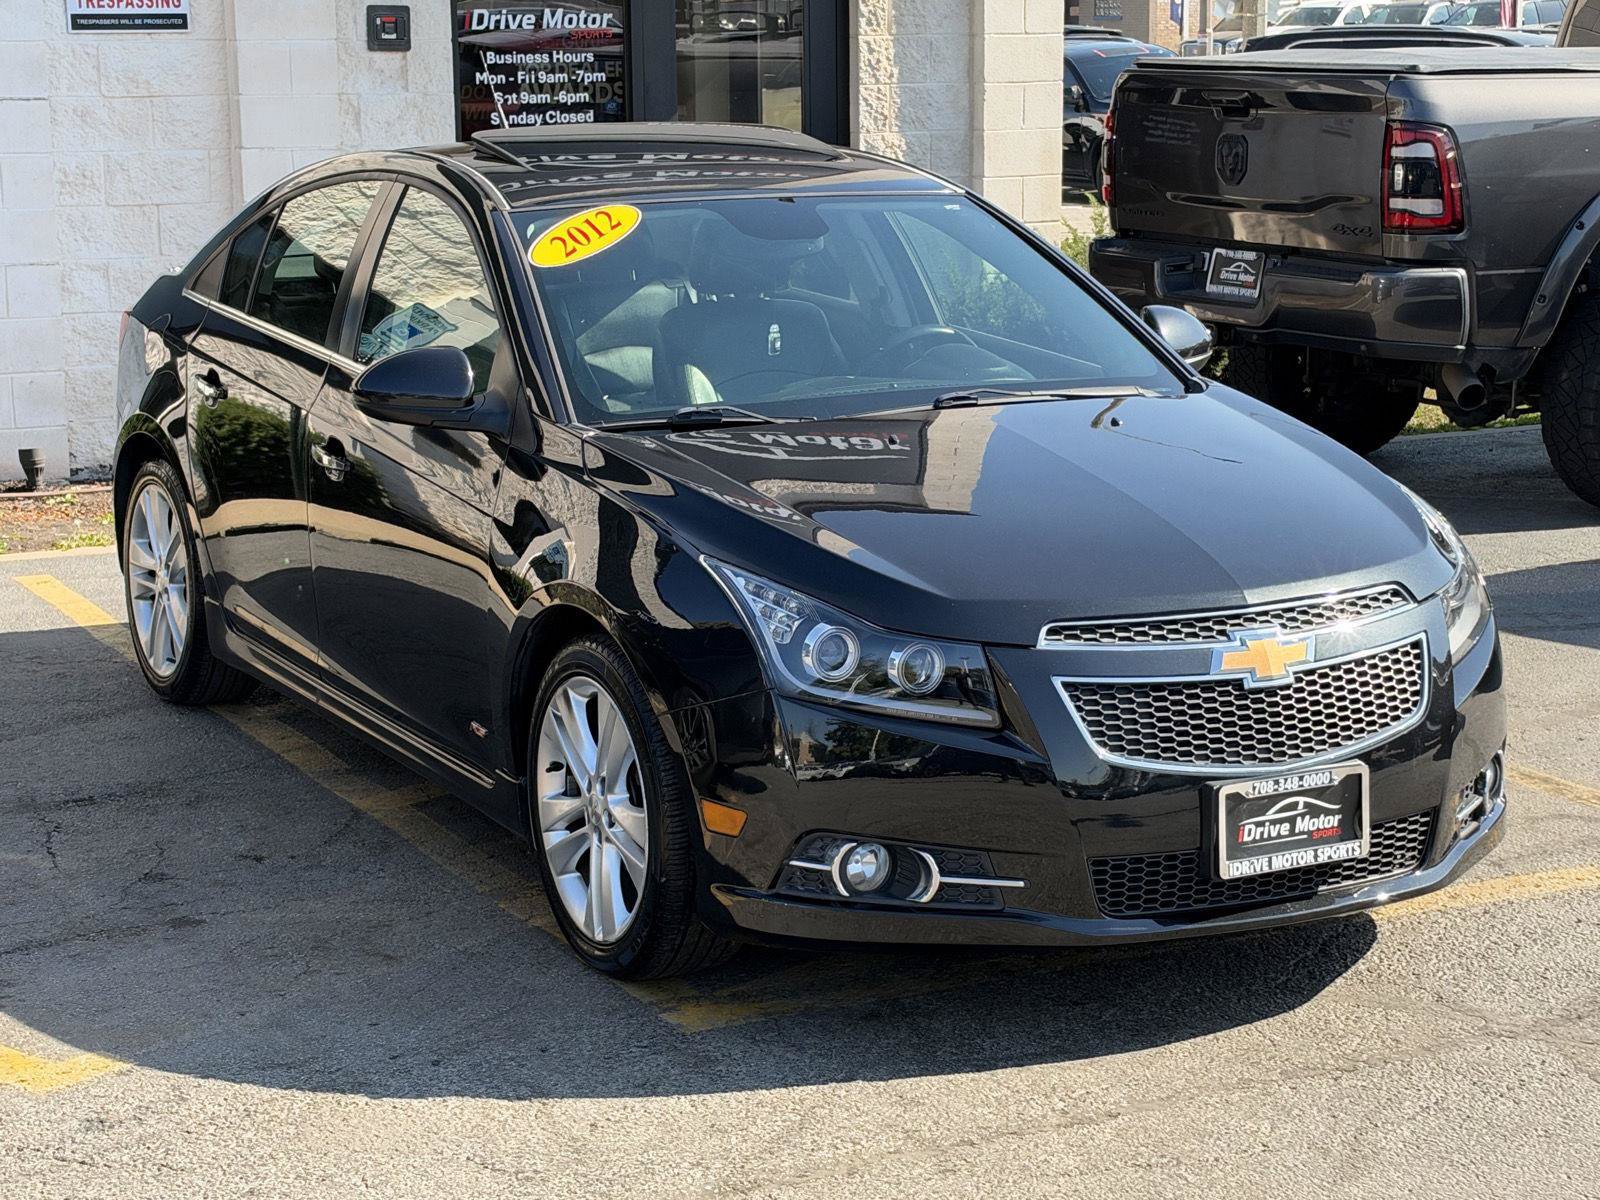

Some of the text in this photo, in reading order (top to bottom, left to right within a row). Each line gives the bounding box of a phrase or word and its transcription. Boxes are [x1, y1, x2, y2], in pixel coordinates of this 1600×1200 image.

[78, 0, 182, 9] TRESPASSING
[542, 8, 613, 29] Motor
[570, 29, 613, 40] SPORTS
[486, 50, 595, 64] Business Hours
[475, 72, 506, 85] Mon
[538, 71, 568, 83] 9am
[519, 92, 550, 105] 9am
[490, 112, 543, 126] Snday
[546, 110, 595, 123] Closed
[550, 210, 622, 258] 2012
[1217, 270, 1238, 281] Drive
[1254, 772, 1331, 796] 708-348-0000
[1238, 814, 1342, 843] iDrive Motor
[1312, 827, 1342, 839] SPORTS
[1272, 851, 1316, 870] MOTOR
[1317, 842, 1361, 860] SPORTS
